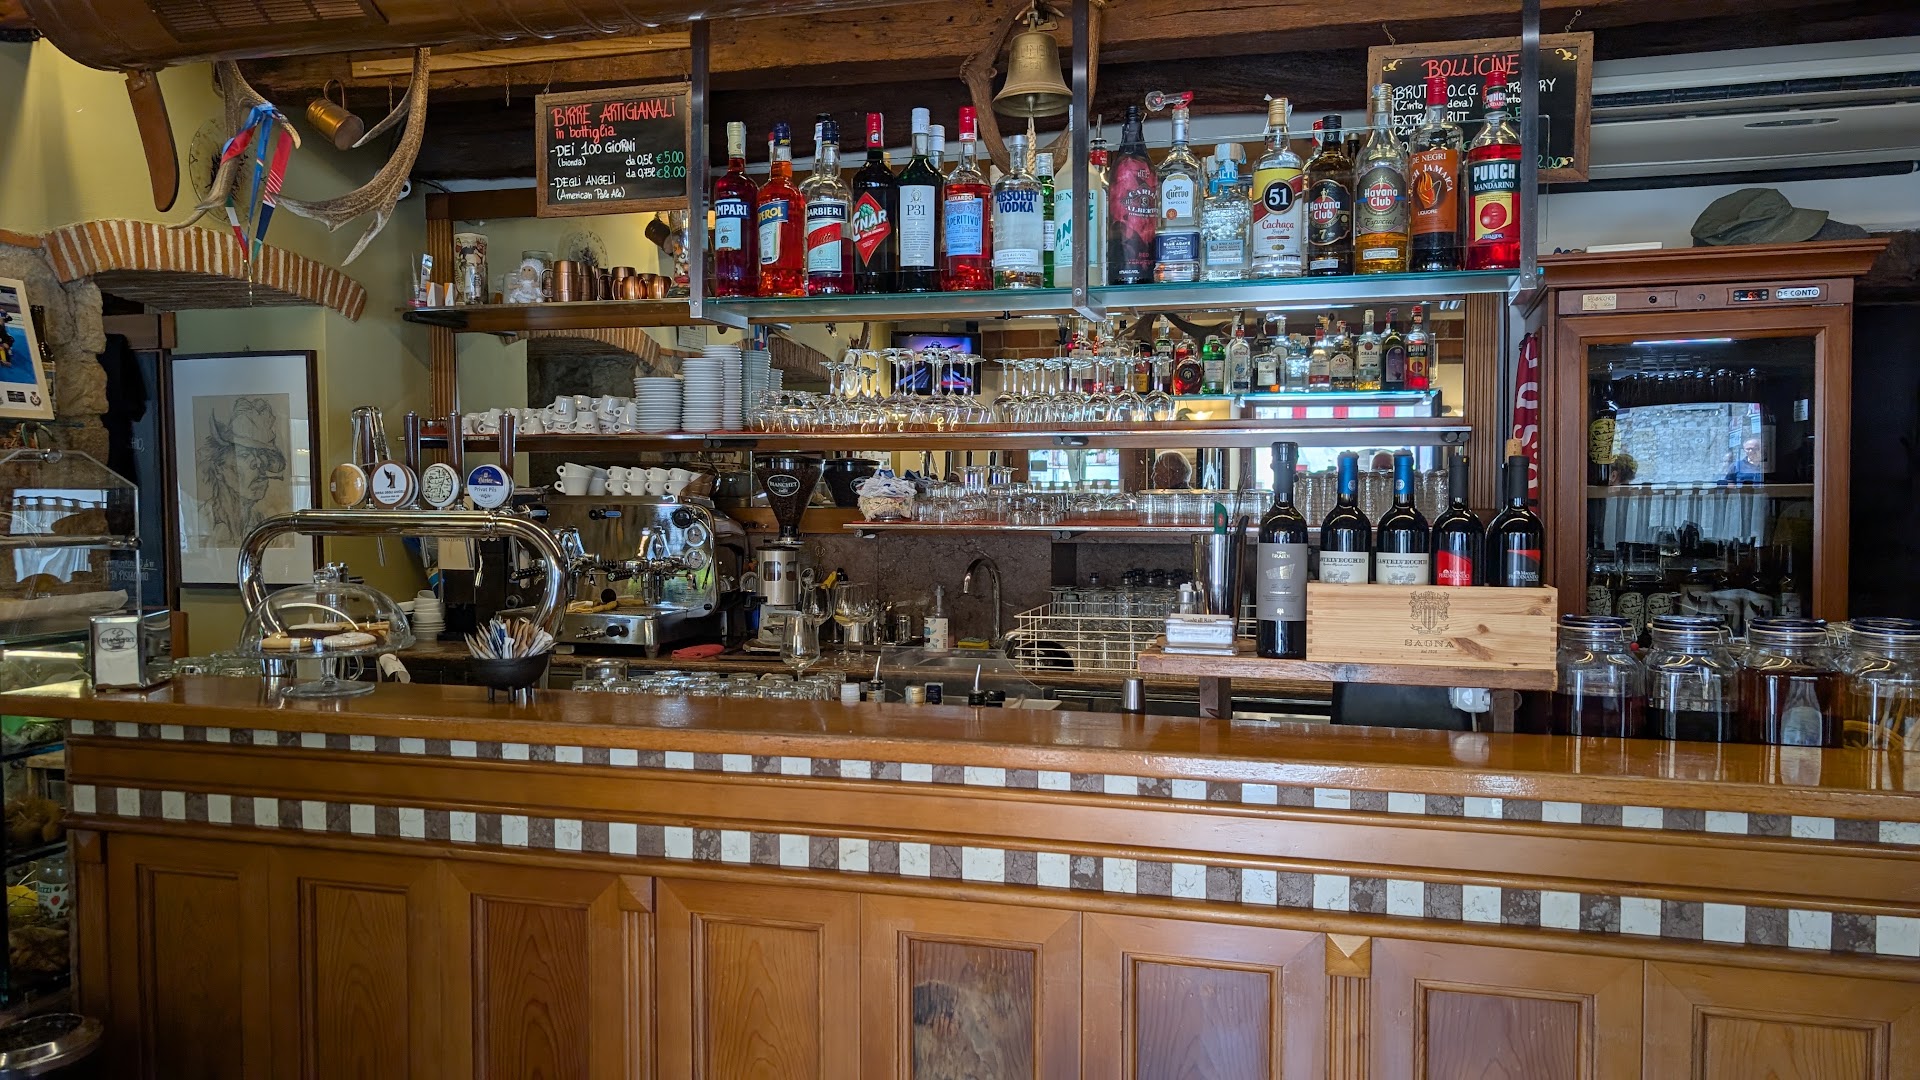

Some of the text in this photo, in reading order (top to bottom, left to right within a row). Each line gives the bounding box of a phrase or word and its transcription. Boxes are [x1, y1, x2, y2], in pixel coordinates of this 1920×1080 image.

[1421, 54, 1519, 79] BOLLICINE
[1392, 83, 1479, 100] BRUT O.C.G.
[1539, 78, 1558, 93] RY
[551, 97, 675, 127] BIRRE ARTIGIANALI
[555, 125, 617, 144] in bottiglia
[581, 141, 602, 156] 100
[605, 138, 636, 153] GIORNI
[558, 156, 586, 167] (bionda)
[626, 156, 636, 166] da
[1421, 153, 1447, 162] NEGRI
[626, 168, 636, 178] da
[1422, 164, 1454, 192] JAMAICA
[1473, 163, 1516, 182] PUNCH
[585, 172, 616, 186] ANGELI
[1473, 181, 1514, 192] MANDARINO
[557, 188, 593, 201] (American
[594, 188, 609, 199] Pale
[996, 190, 1037, 203] ABSOLUT
[1166, 189, 1189, 200] Cuervo
[1268, 188, 1289, 206] 51
[1364, 188, 1398, 198] Havana
[999, 201, 1034, 213] VODKA
[1310, 201, 1341, 211] Havana
[1370, 197, 1391, 207] Club
[906, 205, 926, 216] P31
[1314, 209, 1333, 220] Club
[852, 209, 888, 242] CYNAR
[1319, 229, 1327, 240] 7
[1790, 289, 1819, 297] CONTO
[1404, 639, 1454, 648] SAGNA
